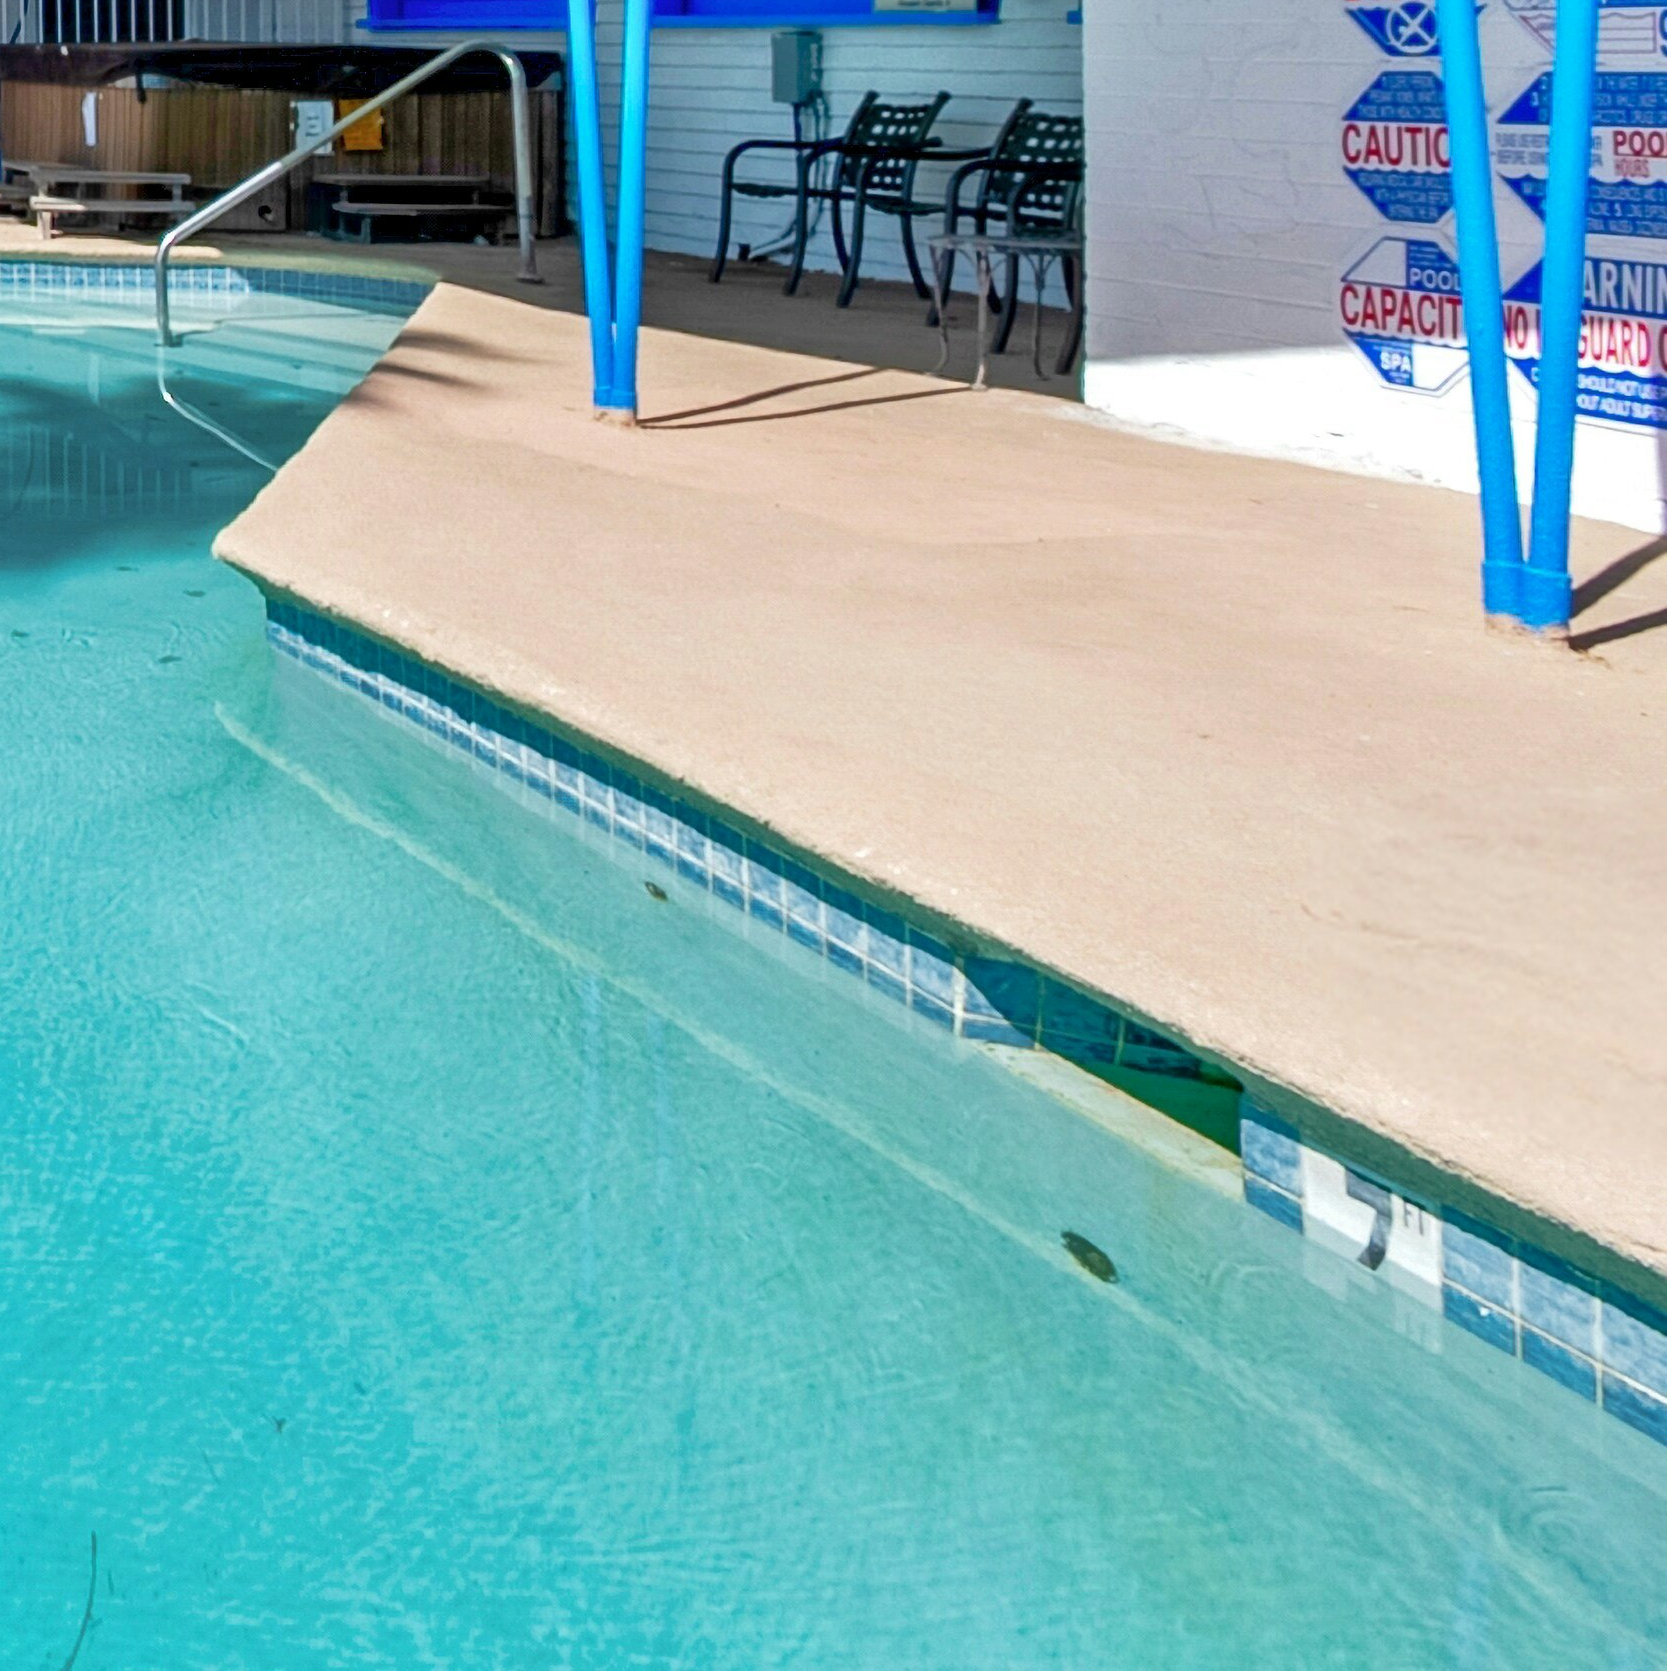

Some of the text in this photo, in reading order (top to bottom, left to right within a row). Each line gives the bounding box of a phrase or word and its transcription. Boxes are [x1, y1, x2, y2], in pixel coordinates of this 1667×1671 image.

[1342, 123, 1453, 168] CAUTIO
[1613, 130, 1667, 156] POO
[1409, 267, 1462, 291] POOL
[1340, 283, 1464, 340] CAPACIT
[1380, 350, 1412, 373] SPA
[1344, 1166, 1393, 1272] 7
